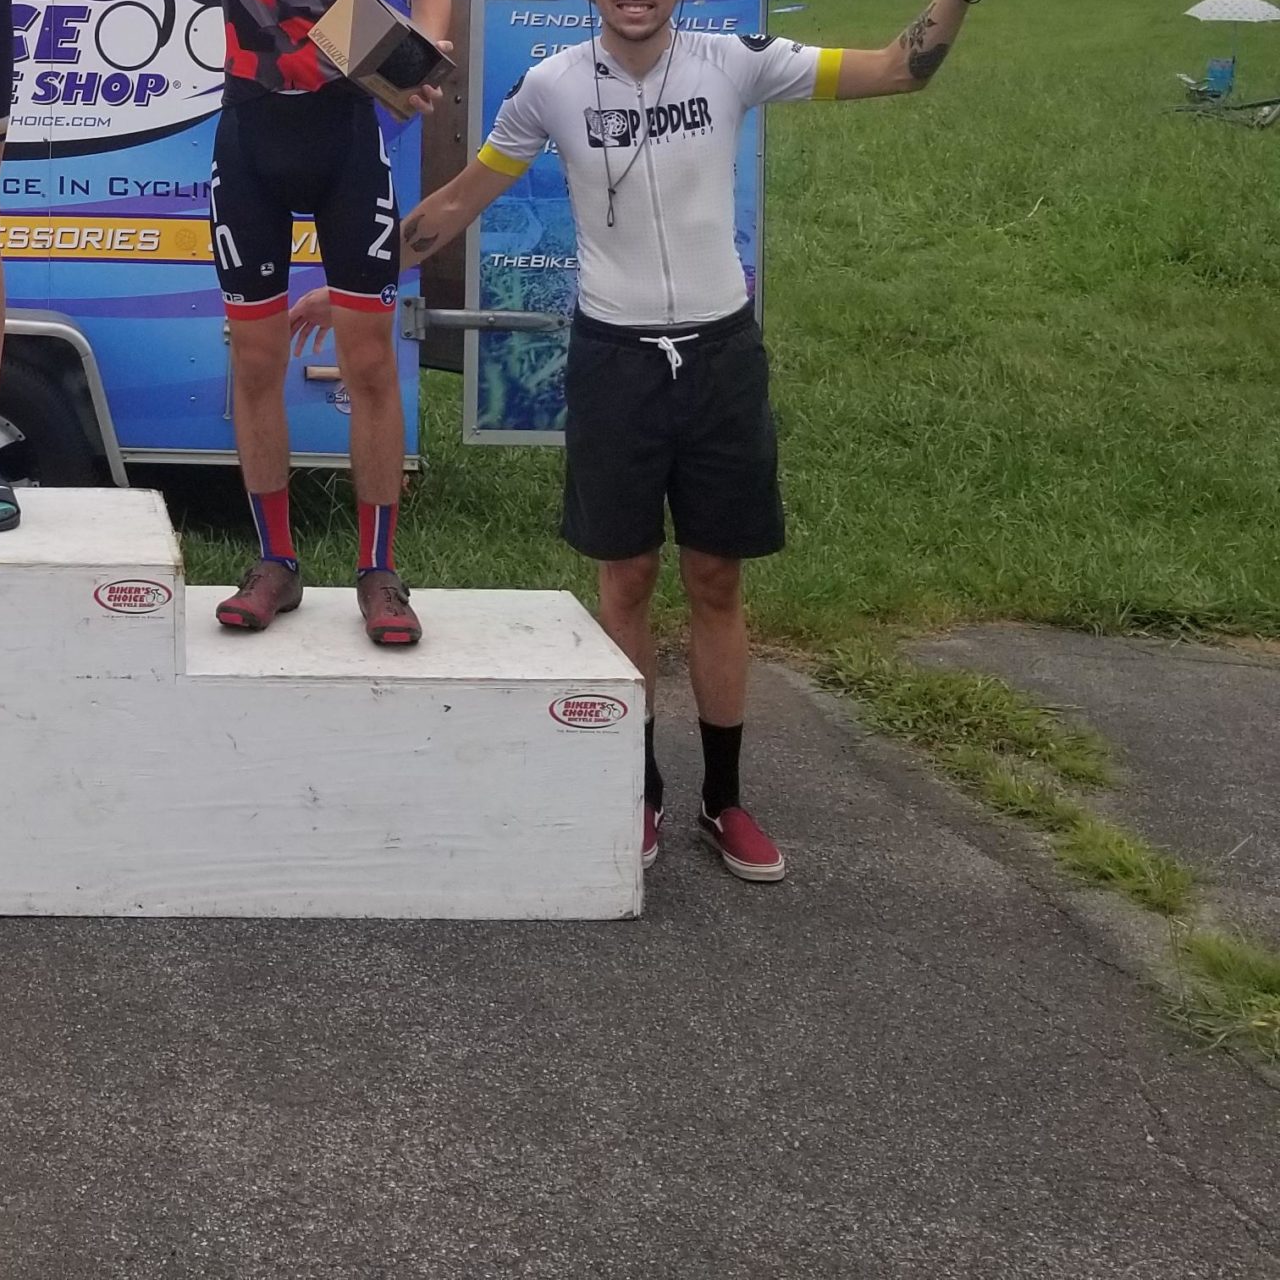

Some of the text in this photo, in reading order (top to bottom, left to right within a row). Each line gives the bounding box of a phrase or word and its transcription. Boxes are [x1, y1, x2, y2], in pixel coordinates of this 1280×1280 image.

[31, 71, 169, 106] SHOP
[628, 97, 713, 139] PEDDLER
[108, 176, 211, 198] CYCLIN
[490, 253, 578, 269] THEBIKE
[108, 586, 152, 595] BIKER'S
[107, 594, 146, 603] CHOICE
[564, 701, 607, 710] BIKER'S
[562, 709, 601, 718] CHOICE
